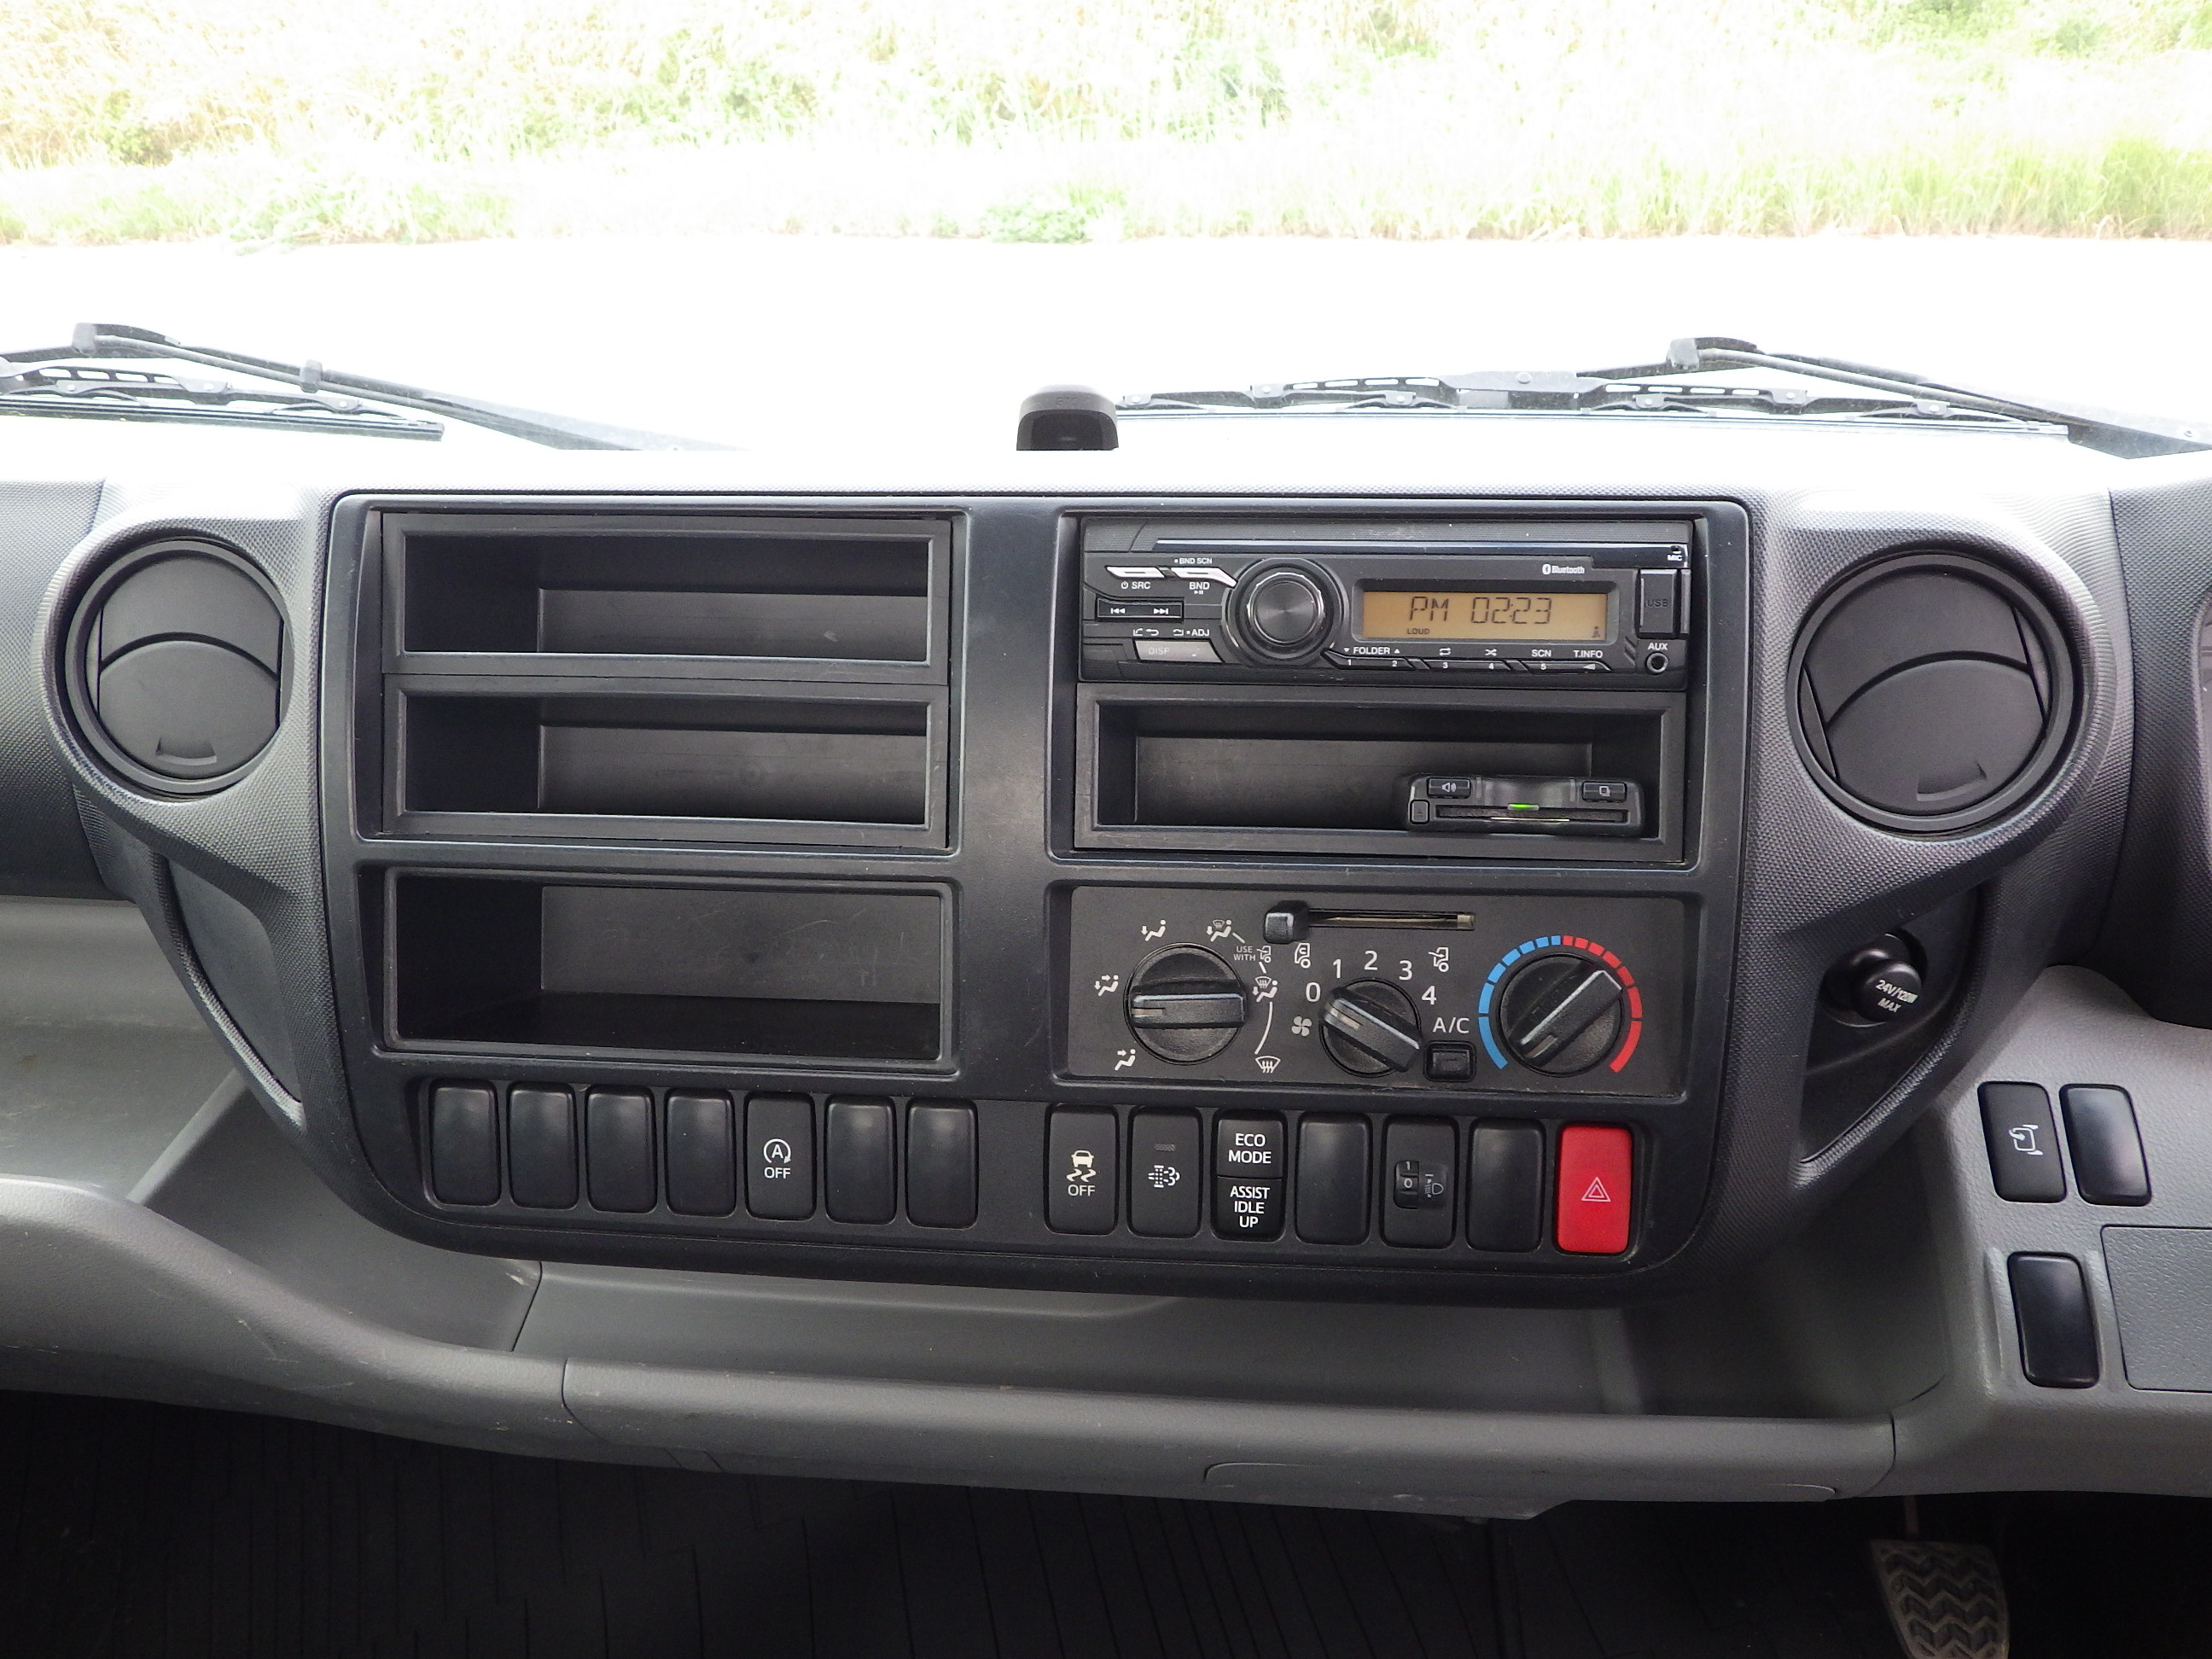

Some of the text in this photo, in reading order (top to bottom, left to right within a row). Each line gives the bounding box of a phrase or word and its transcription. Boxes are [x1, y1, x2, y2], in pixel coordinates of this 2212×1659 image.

[1551, 565, 1585, 574] Bluetooth
[1131, 580, 1151, 590] SRC
[1189, 581, 1210, 590] BND
[1410, 596, 1449, 621] PM
[1645, 598, 1669, 608] USB
[1191, 628, 1210, 637] ADJ
[1148, 647, 1170, 655] DISP
[1353, 646, 1391, 655] FOLDER
[1647, 642, 1668, 651] AUX
[1531, 649, 1552, 658] SCN
[1573, 649, 1604, 659] T.INFO
[1233, 953, 1256, 962] WITH
[1364, 950, 1379, 971] 2
[1332, 958, 1342, 979] 1
[1399, 960, 1413, 981] 3
[1306, 981, 1321, 1003] 0
[1421, 985, 1437, 1005] 4
[1877, 998, 1902, 1013] MAX
[1432, 1016, 1470, 1034] A/C
[1235, 1133, 1266, 1147] ECO
[771, 1144, 783, 1159] A
[1228, 1150, 1272, 1164] MODE
[764, 1167, 791, 1179] OFF
[1068, 1185, 1096, 1196] OFF
[1230, 1186, 1270, 1200] ASSIST
[1234, 1201, 1265, 1214] IDLE
[1239, 1216, 1259, 1228] UP
